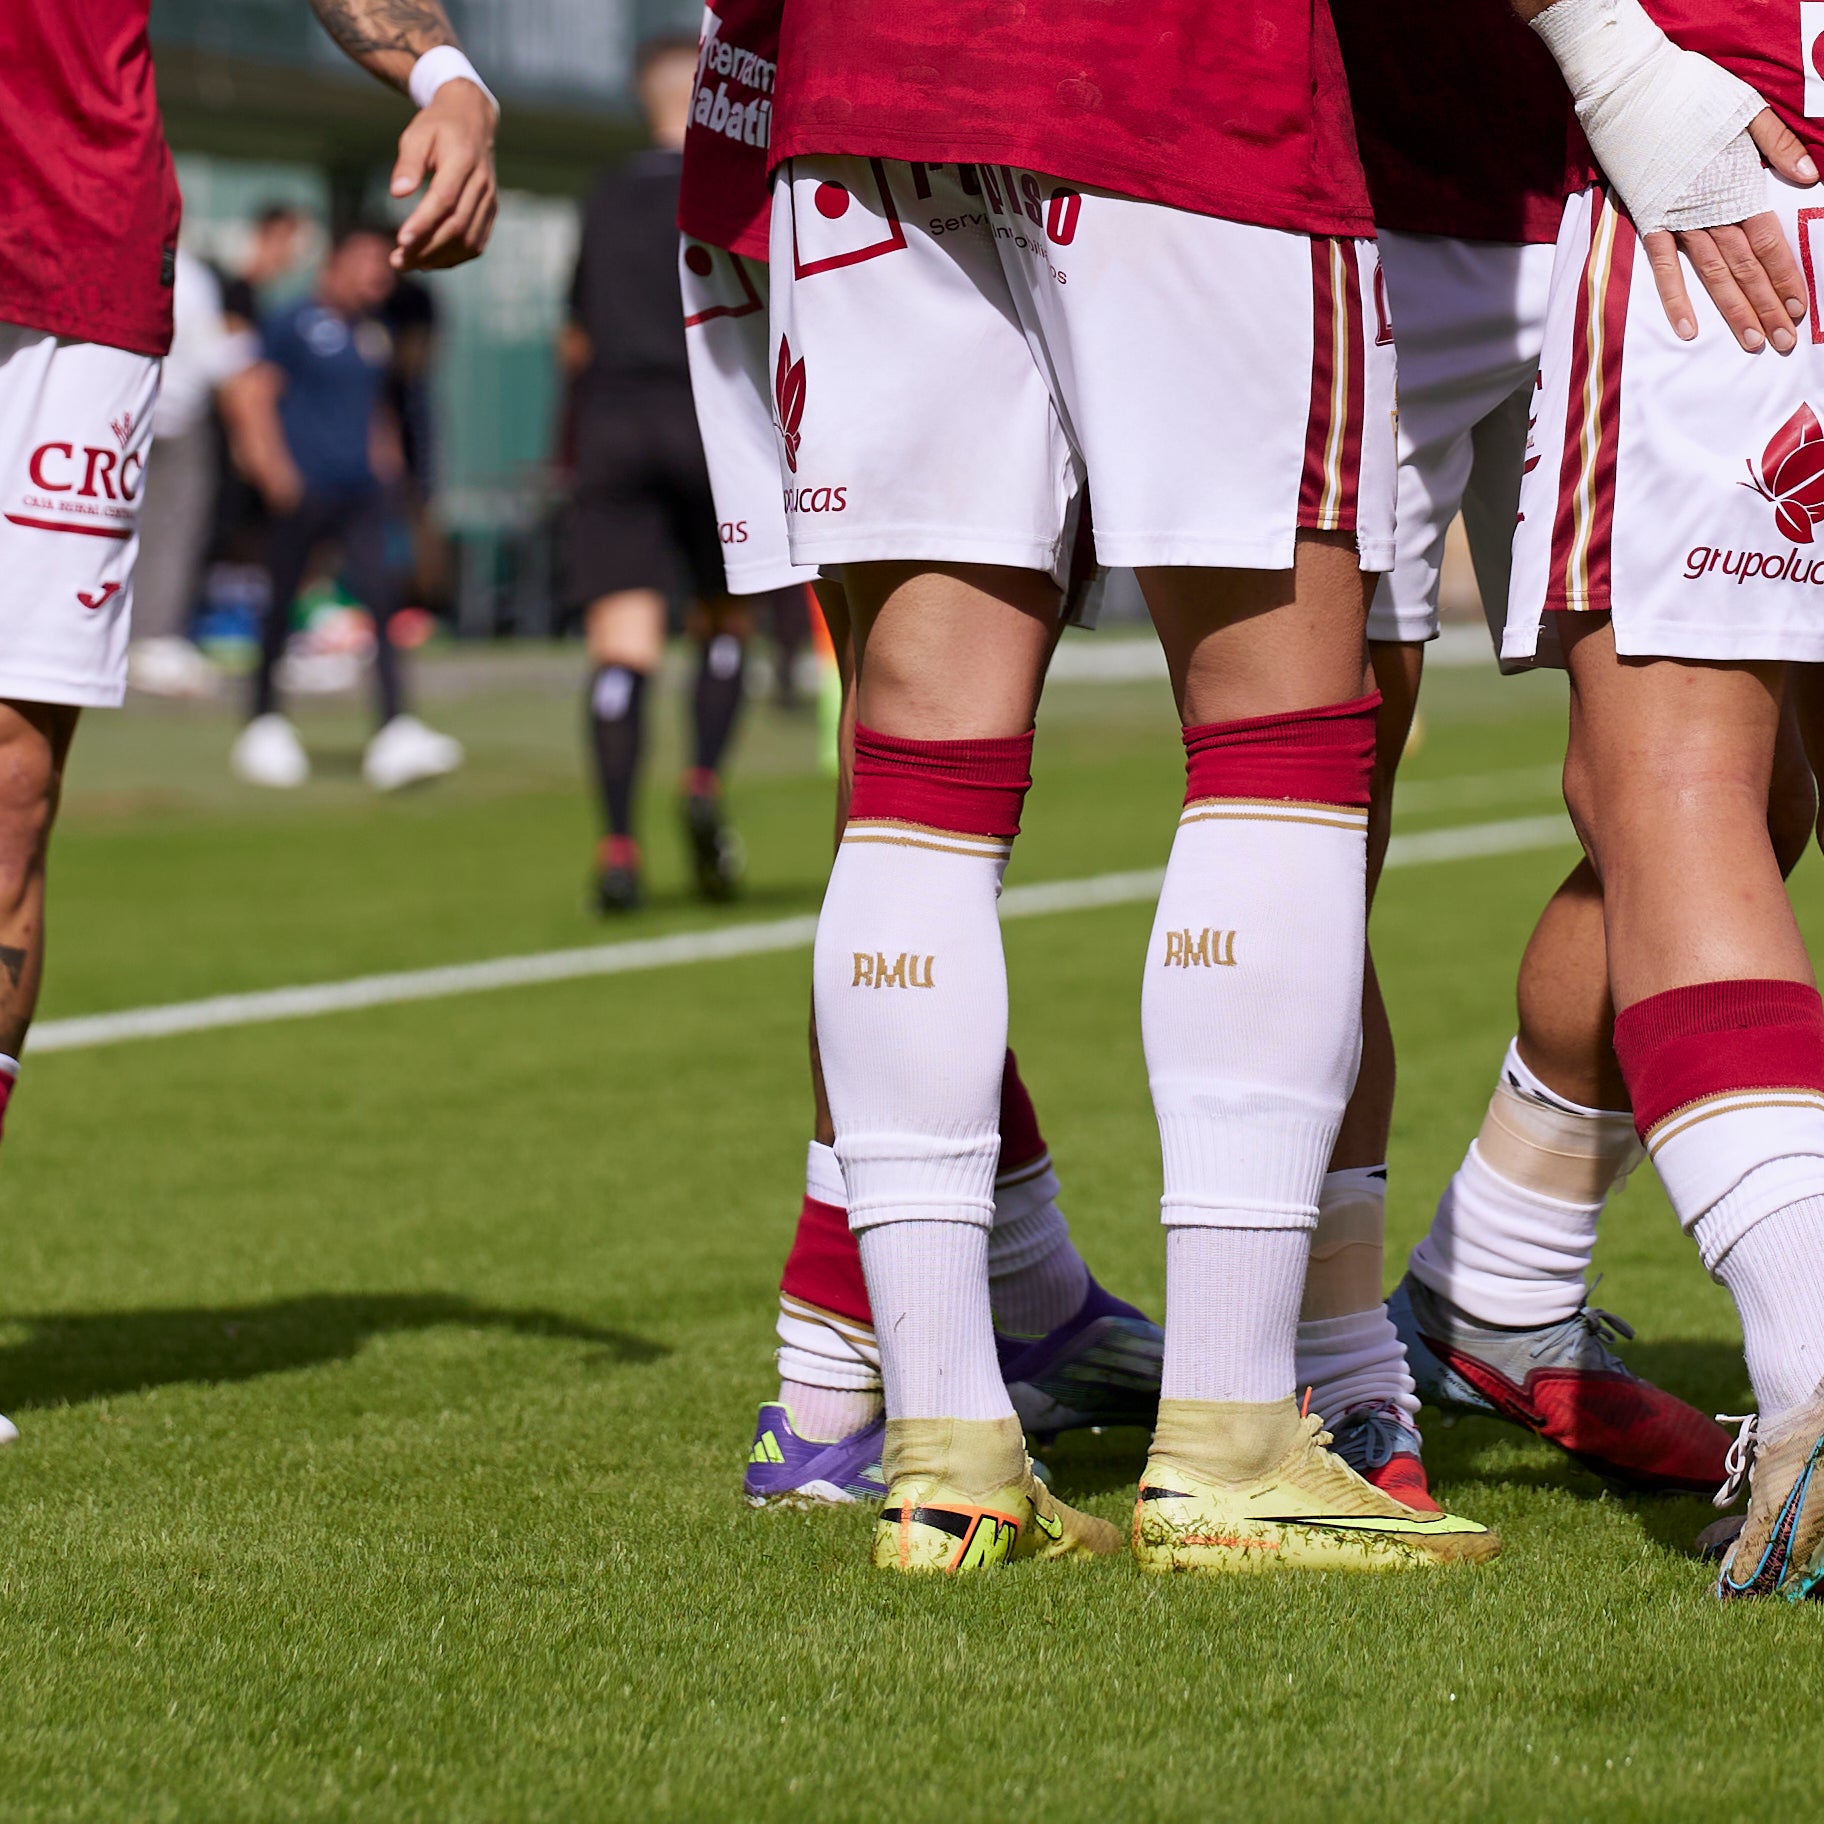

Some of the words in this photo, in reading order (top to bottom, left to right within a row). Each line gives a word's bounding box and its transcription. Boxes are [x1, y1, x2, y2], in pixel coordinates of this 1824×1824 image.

[29, 441, 143, 502] CRC
[1163, 928, 1237, 969] RMU
[852, 951, 936, 990] RMU
